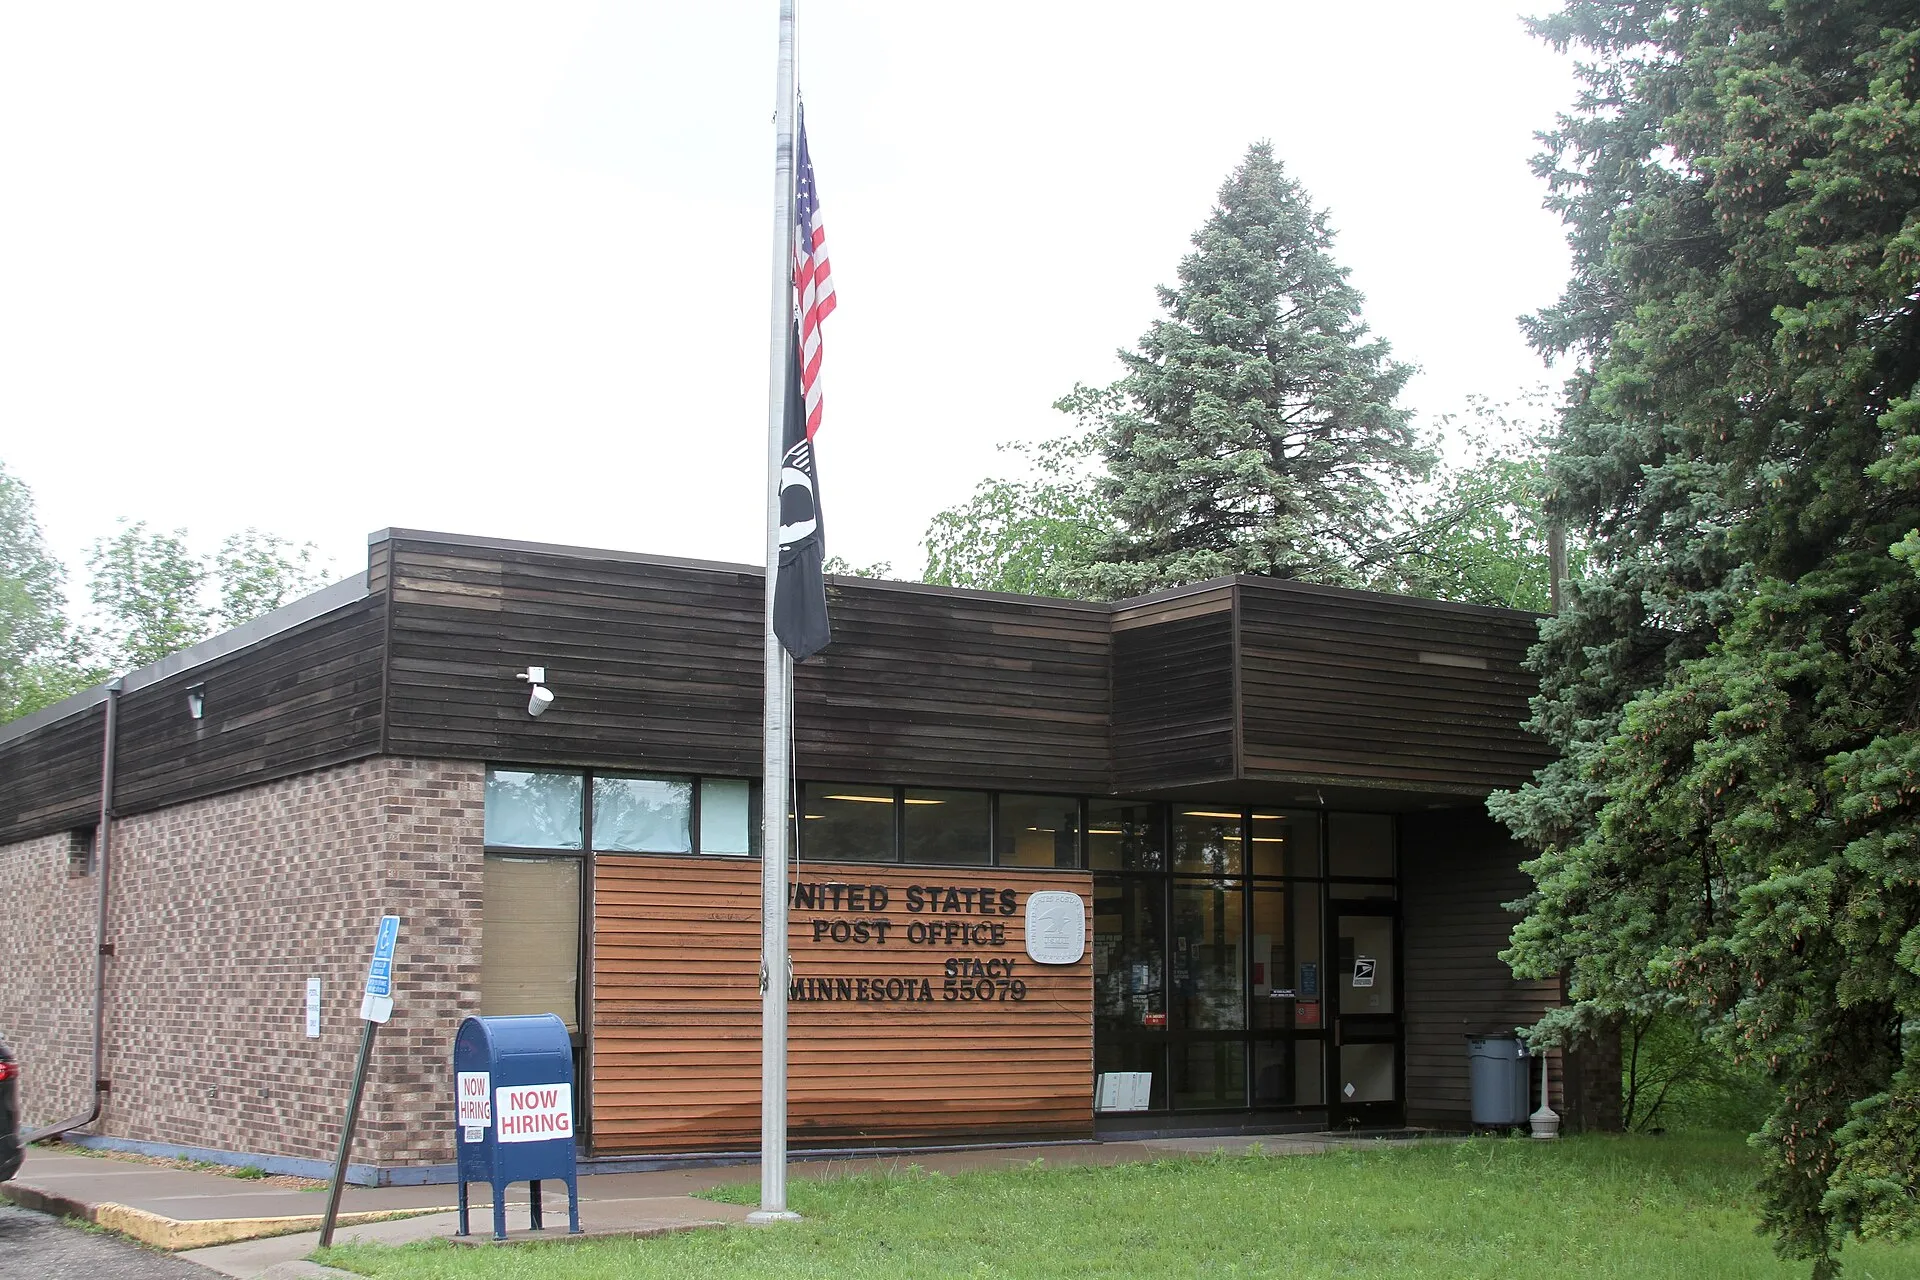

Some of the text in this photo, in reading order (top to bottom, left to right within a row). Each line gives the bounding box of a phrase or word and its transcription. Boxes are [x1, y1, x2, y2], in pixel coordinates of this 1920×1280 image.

[905, 885, 1017, 916] STATES
[812, 919, 1005, 946] POST OFFICE
[944, 957, 1016, 979] STACY
[788, 977, 1027, 1001] MINNESOTA 55079
[464, 1078, 485, 1096] NOW
[460, 1101, 490, 1120] HIRING
[510, 1090, 558, 1111] NOW
[502, 1112, 569, 1135] HIRING
